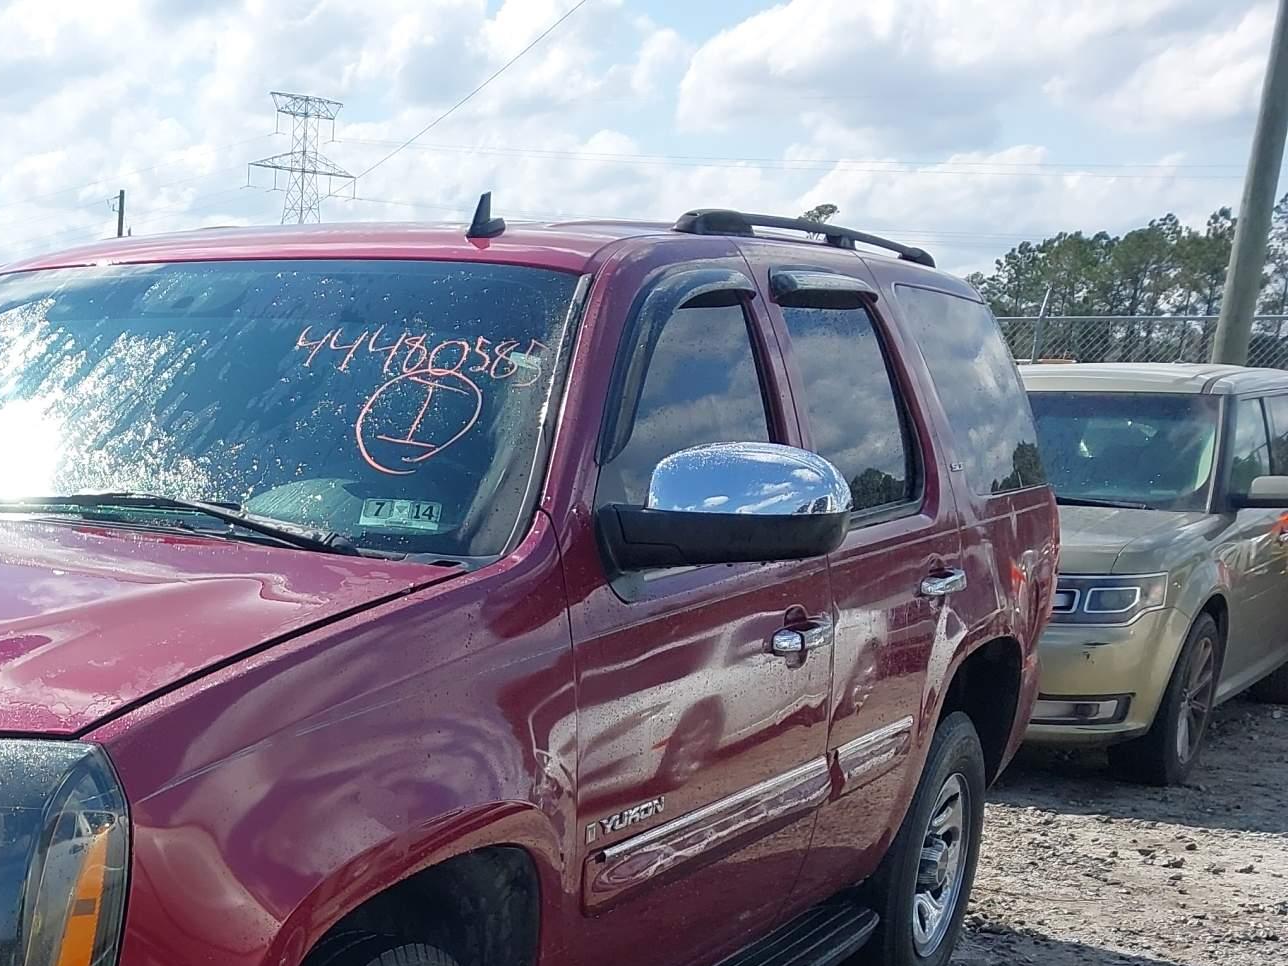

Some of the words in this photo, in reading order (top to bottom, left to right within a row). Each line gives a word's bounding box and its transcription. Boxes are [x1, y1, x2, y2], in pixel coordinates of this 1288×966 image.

[297, 325, 548, 387] 44480585
[374, 502, 385, 517] 7
[414, 504, 434, 520] 14
[599, 796, 665, 834] YUKON
